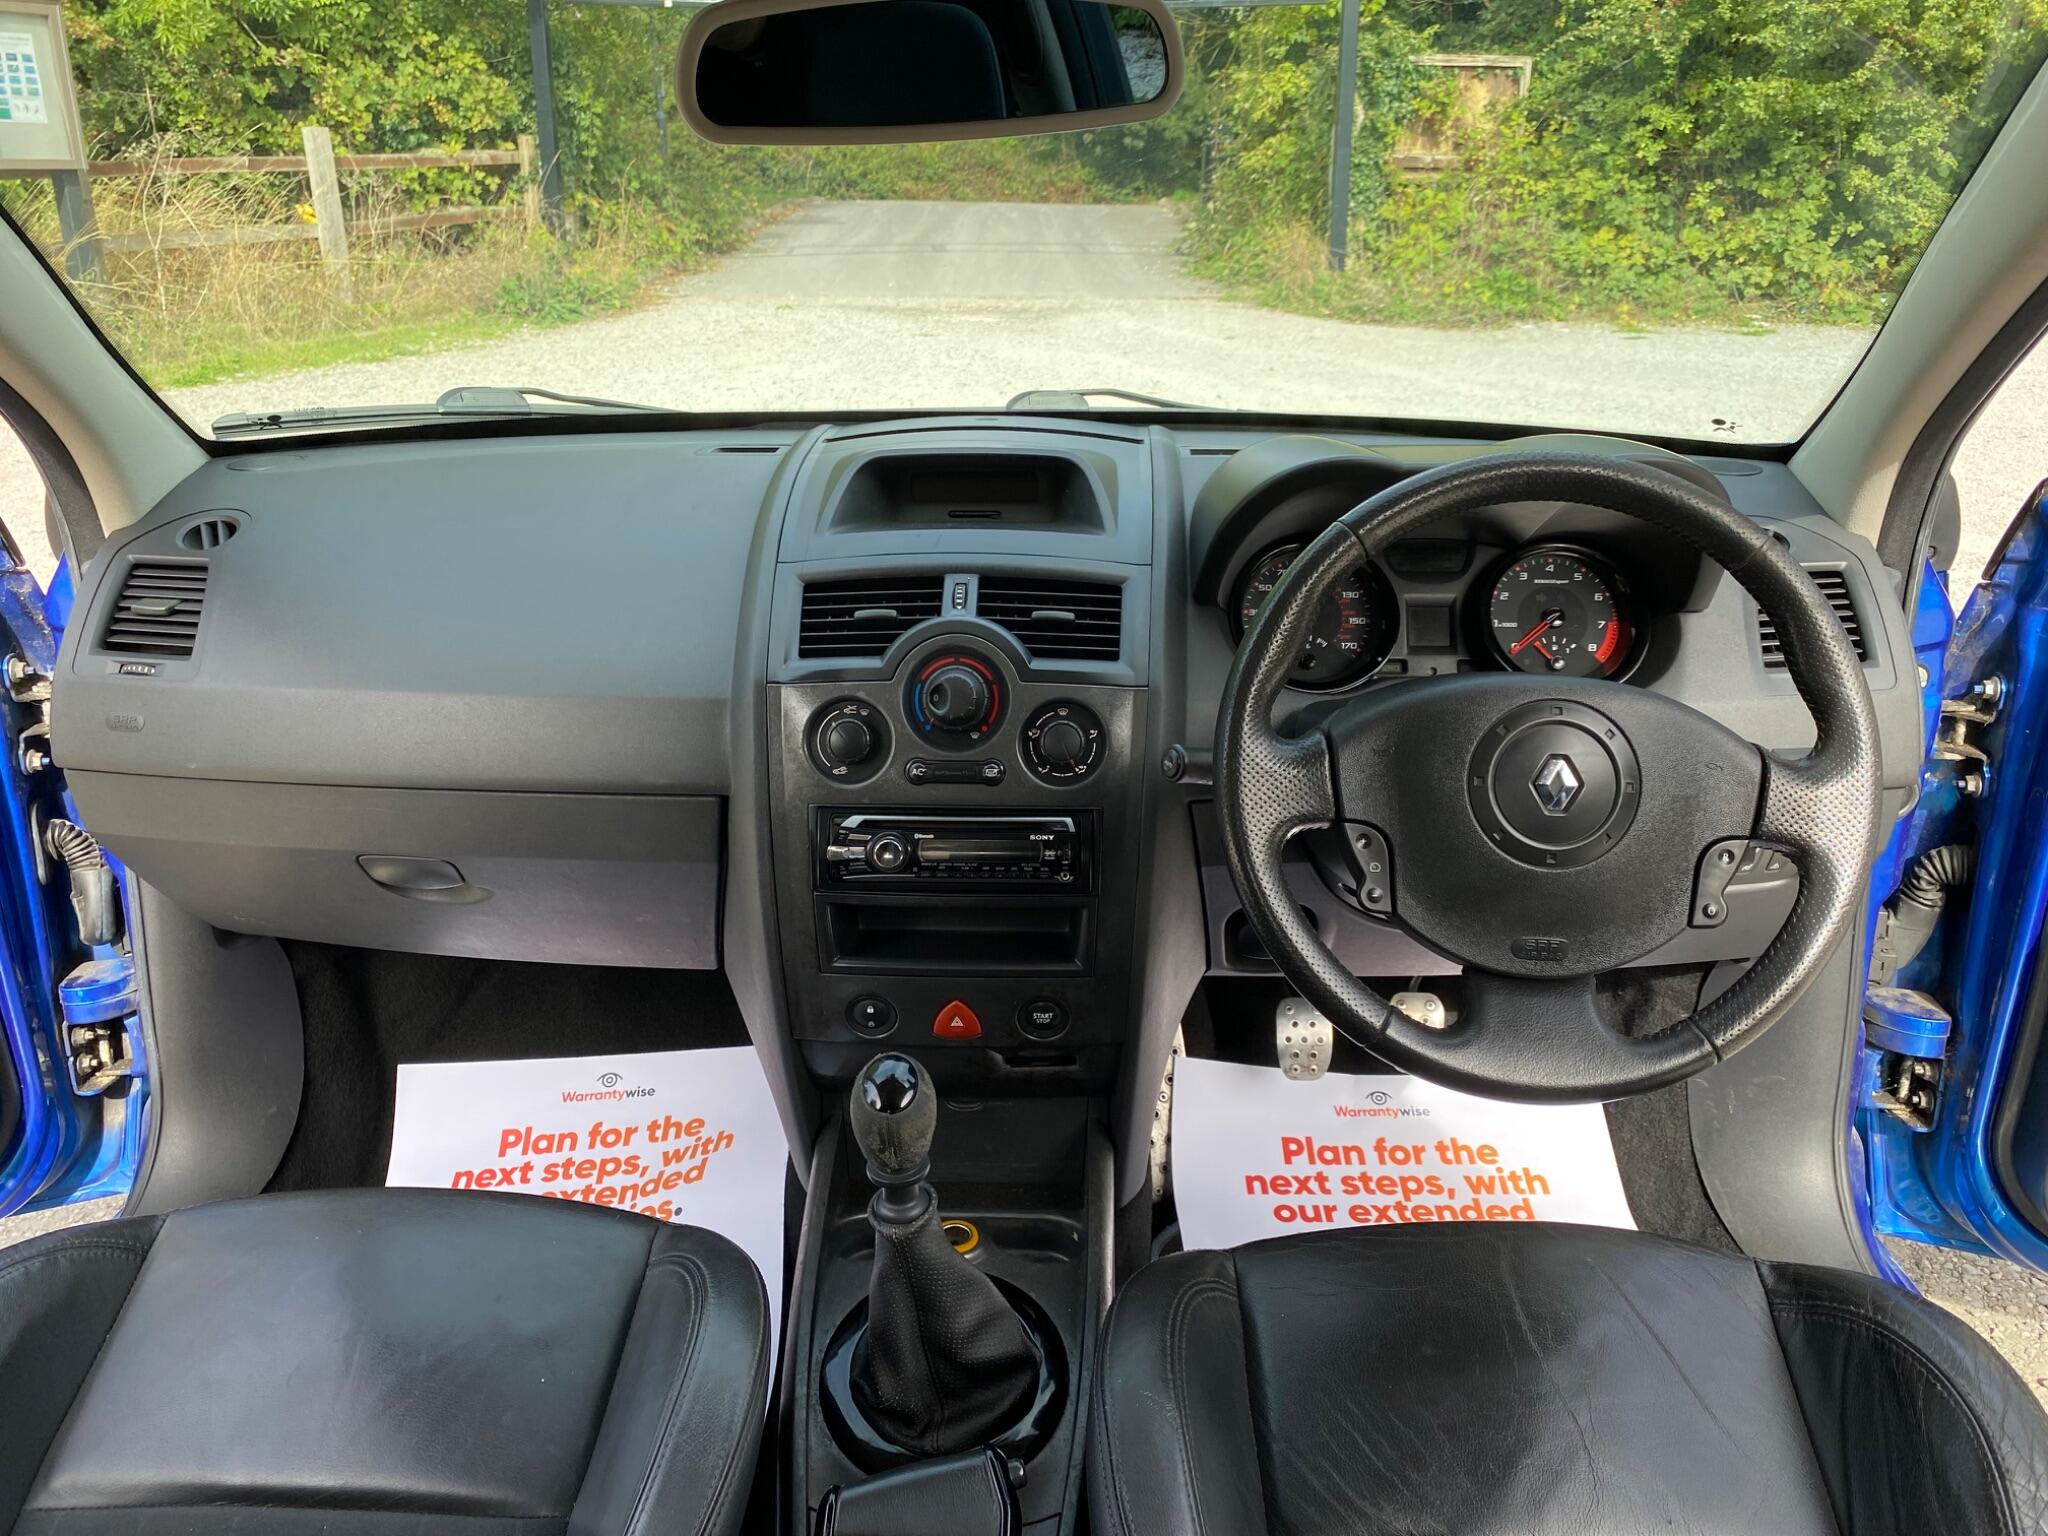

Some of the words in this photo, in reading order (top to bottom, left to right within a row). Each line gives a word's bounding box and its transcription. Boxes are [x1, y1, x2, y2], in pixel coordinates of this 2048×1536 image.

[1545, 564, 1554, 572] 4
[1519, 572, 1528, 580] 3
[1573, 573, 1582, 581] 5
[1342, 591, 1359, 599] 130
[1500, 592, 1509, 600] 2
[1594, 593, 1603, 601] 6
[1348, 617, 1366, 625] 150
[1597, 621, 1606, 629] 7
[1341, 642, 1358, 650] 170
[1588, 643, 1597, 652] 8
[561, 1086, 656, 1103] Warrantywise
[1333, 1105, 1431, 1119] Warrantywise
[498, 1126, 579, 1158] Plan
[587, 1121, 639, 1150] for
[646, 1115, 706, 1144] the
[1281, 1136, 1367, 1166] Plan
[1374, 1136, 1427, 1166] for
[1434, 1136, 1500, 1166] the
[451, 1161, 534, 1190] next
[541, 1154, 650, 1184] steps,
[662, 1130, 735, 1167] with
[1244, 1170, 1333, 1196] next
[1340, 1170, 1456, 1202] steps,
[1463, 1166, 1551, 1196] with
[1273, 1203, 1338, 1224] our
[1348, 1197, 1537, 1224] extended
